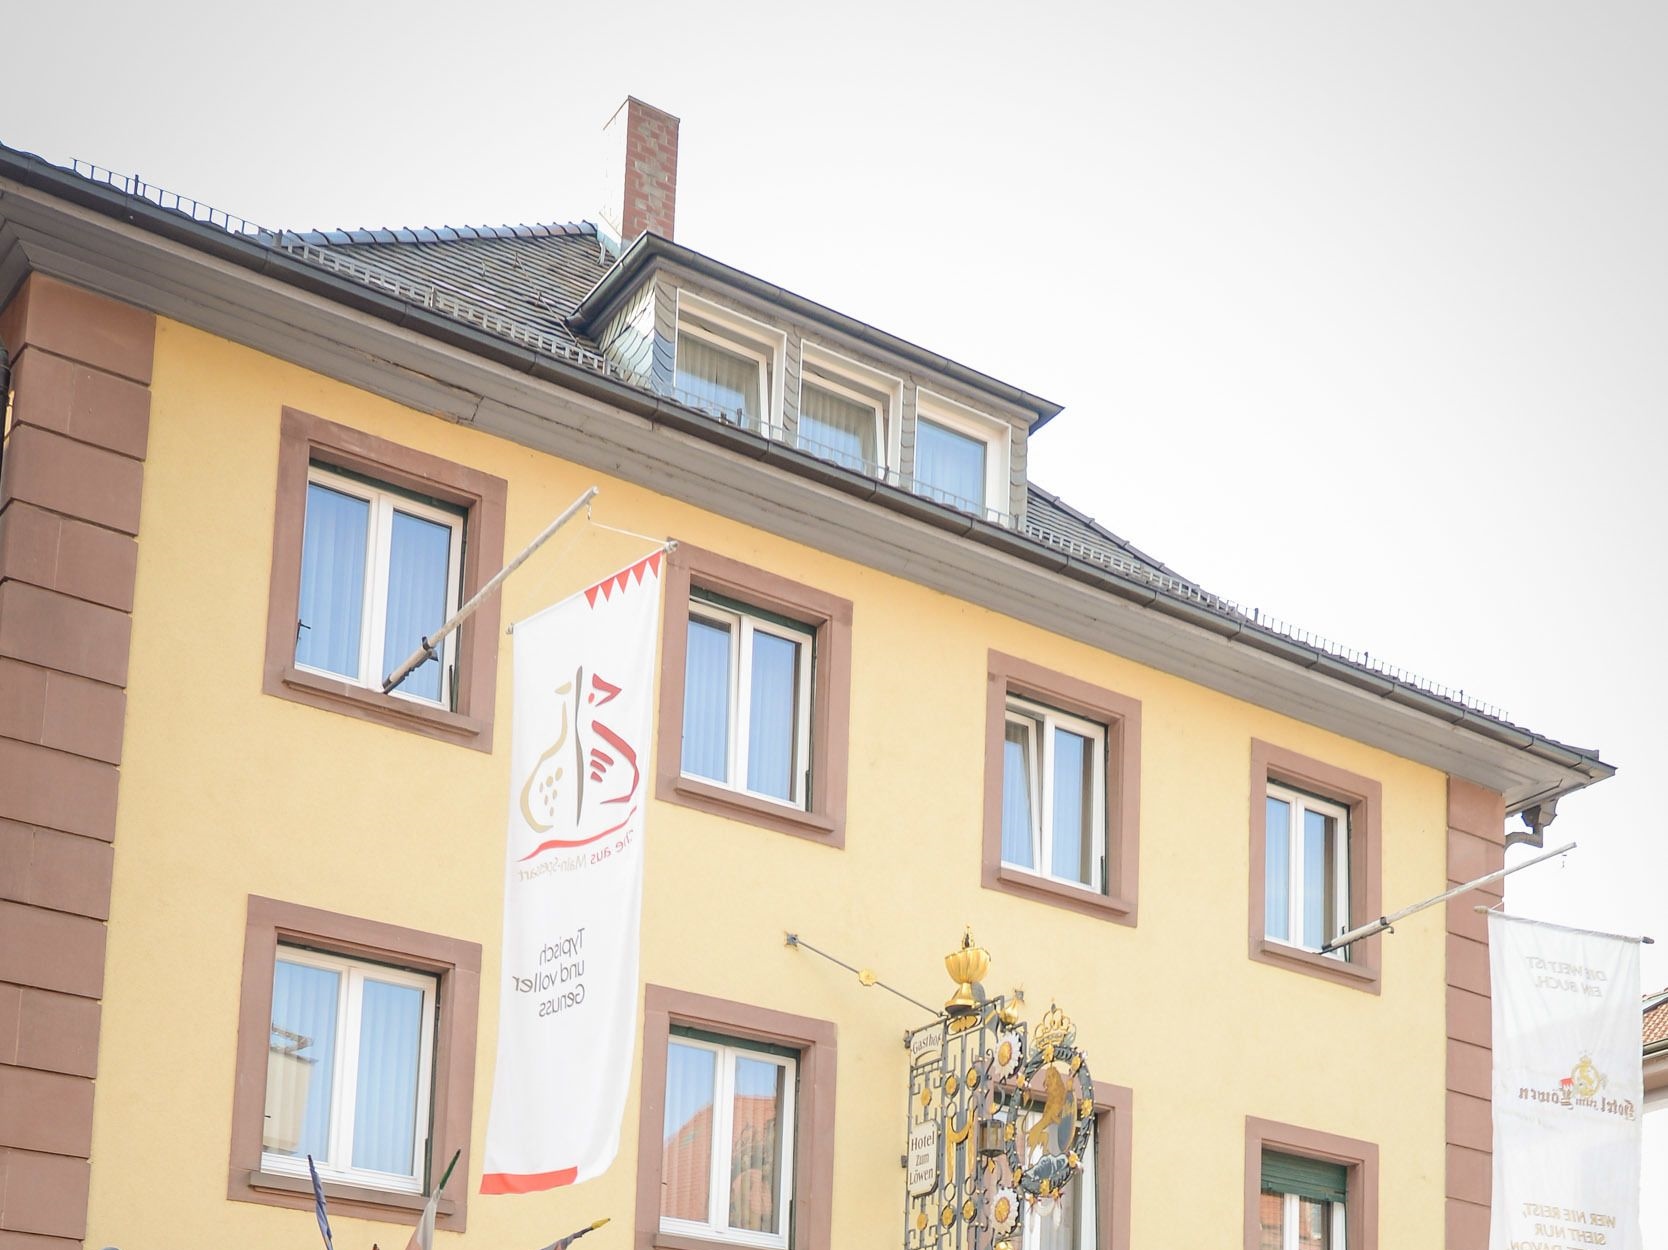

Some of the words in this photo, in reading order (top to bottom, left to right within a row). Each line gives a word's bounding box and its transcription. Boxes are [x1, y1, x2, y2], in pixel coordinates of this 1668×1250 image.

[912, 1032, 942, 1054] Gasthof
[911, 1131, 935, 1151] Hotel
[909, 1167, 933, 1185] Löwen
